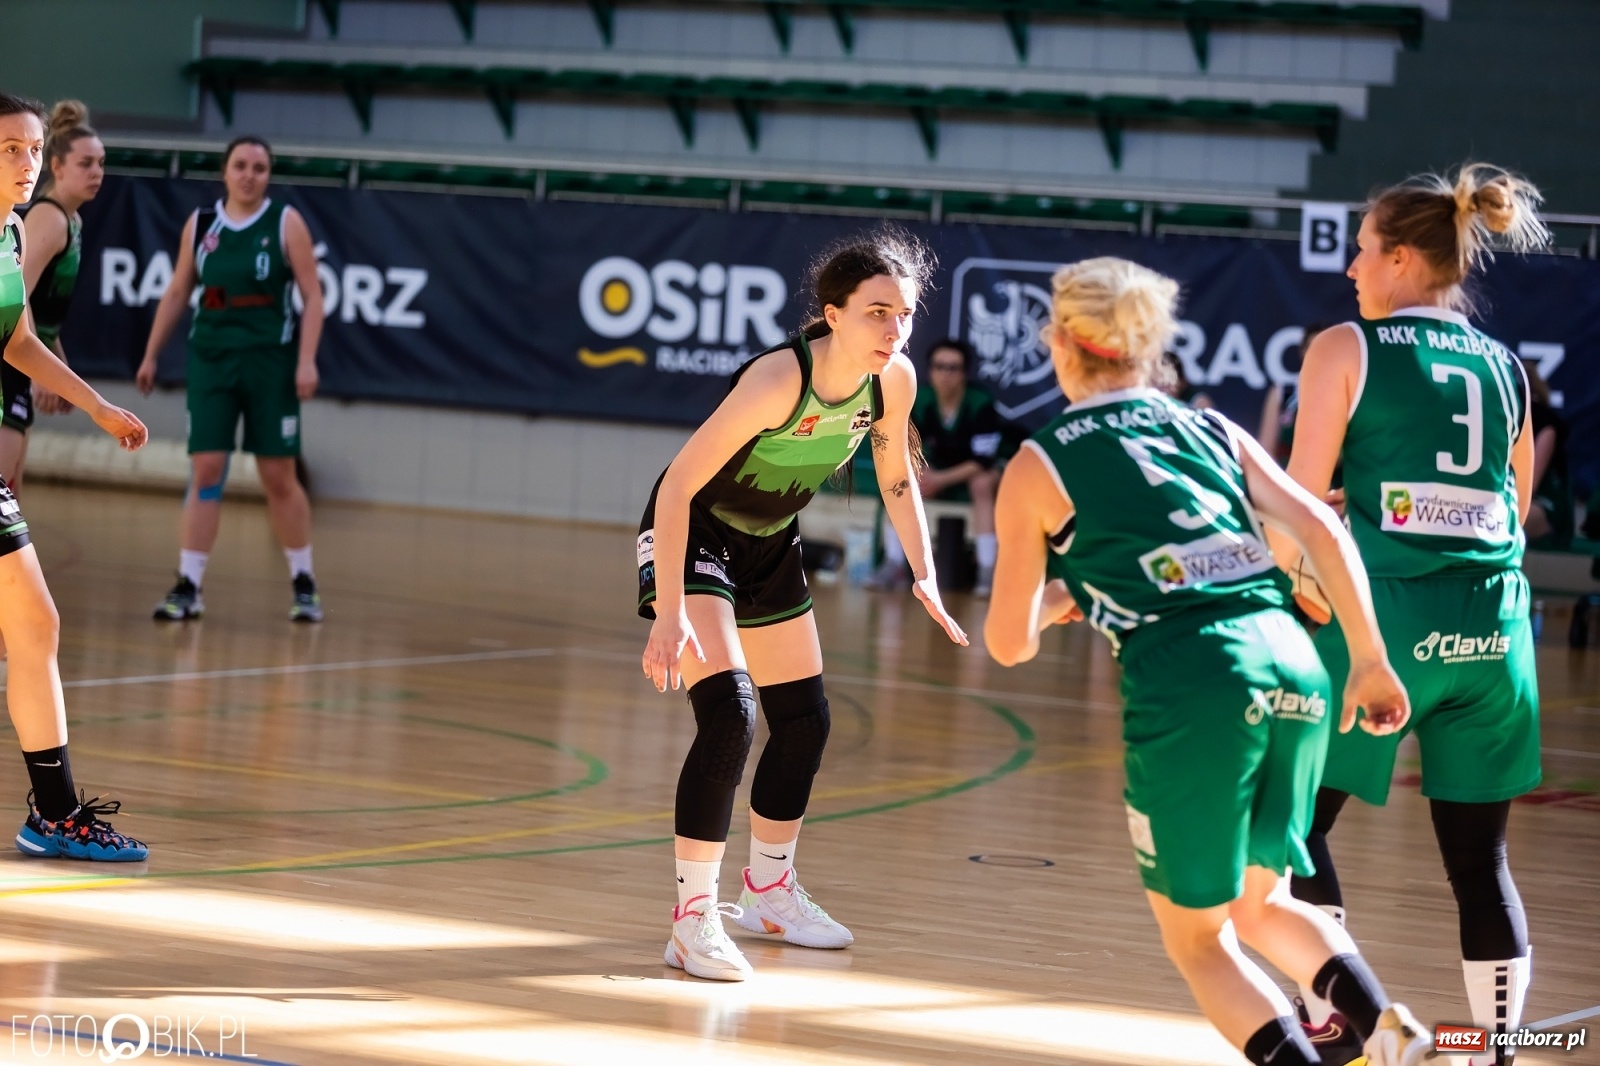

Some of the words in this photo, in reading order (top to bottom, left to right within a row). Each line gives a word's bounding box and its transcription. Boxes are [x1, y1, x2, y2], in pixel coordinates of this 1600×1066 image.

[1310, 218, 1338, 253] B
[256, 252, 270, 281] 9
[101, 242, 427, 327] RAÓRZ
[1377, 325, 1420, 345] RKK
[1054, 415, 1101, 446] RKK
[1431, 363, 1483, 475] 3
[1439, 630, 1511, 657] Clavis
